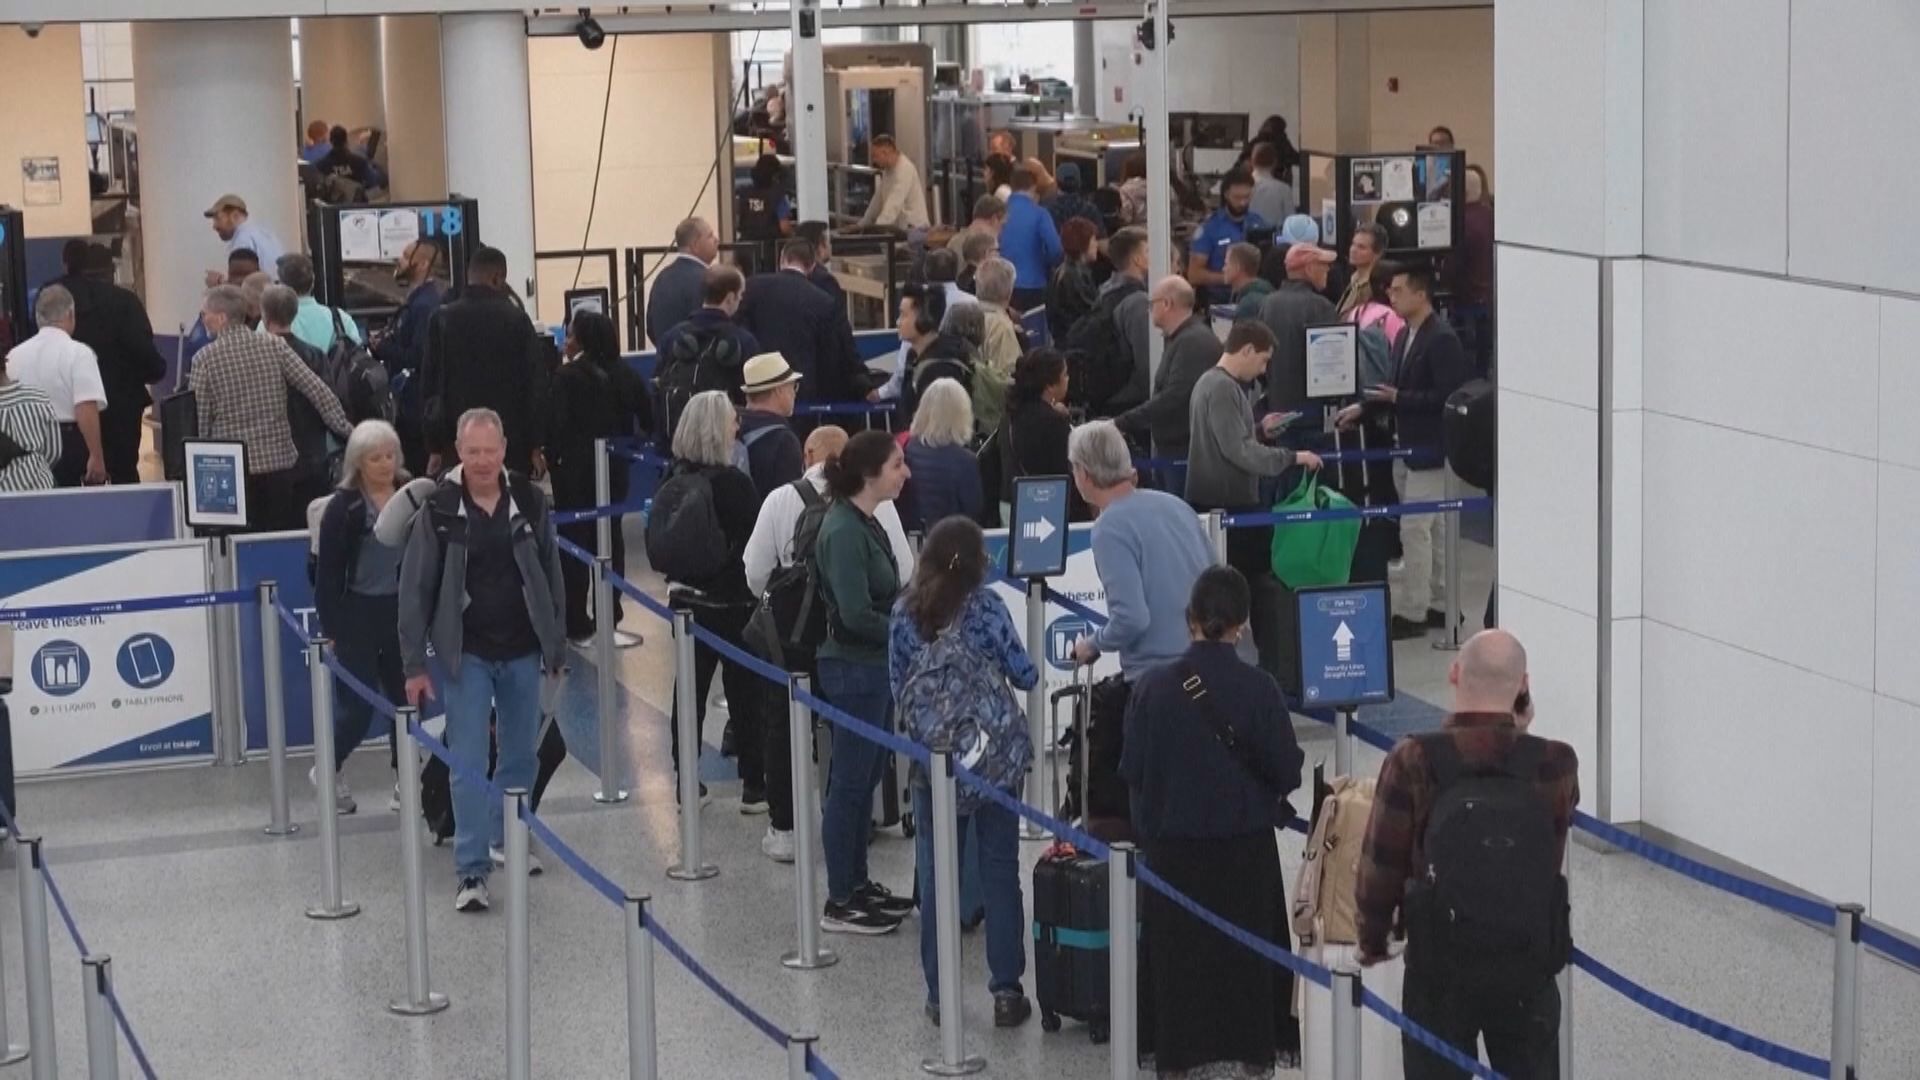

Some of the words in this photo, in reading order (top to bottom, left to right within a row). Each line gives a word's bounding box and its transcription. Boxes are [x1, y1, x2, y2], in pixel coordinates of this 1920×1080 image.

[420, 206, 462, 237] 18
[52, 616, 87, 629] these
[65, 702, 96, 713] LIQUIDS
[139, 742, 162, 752] Enroll
